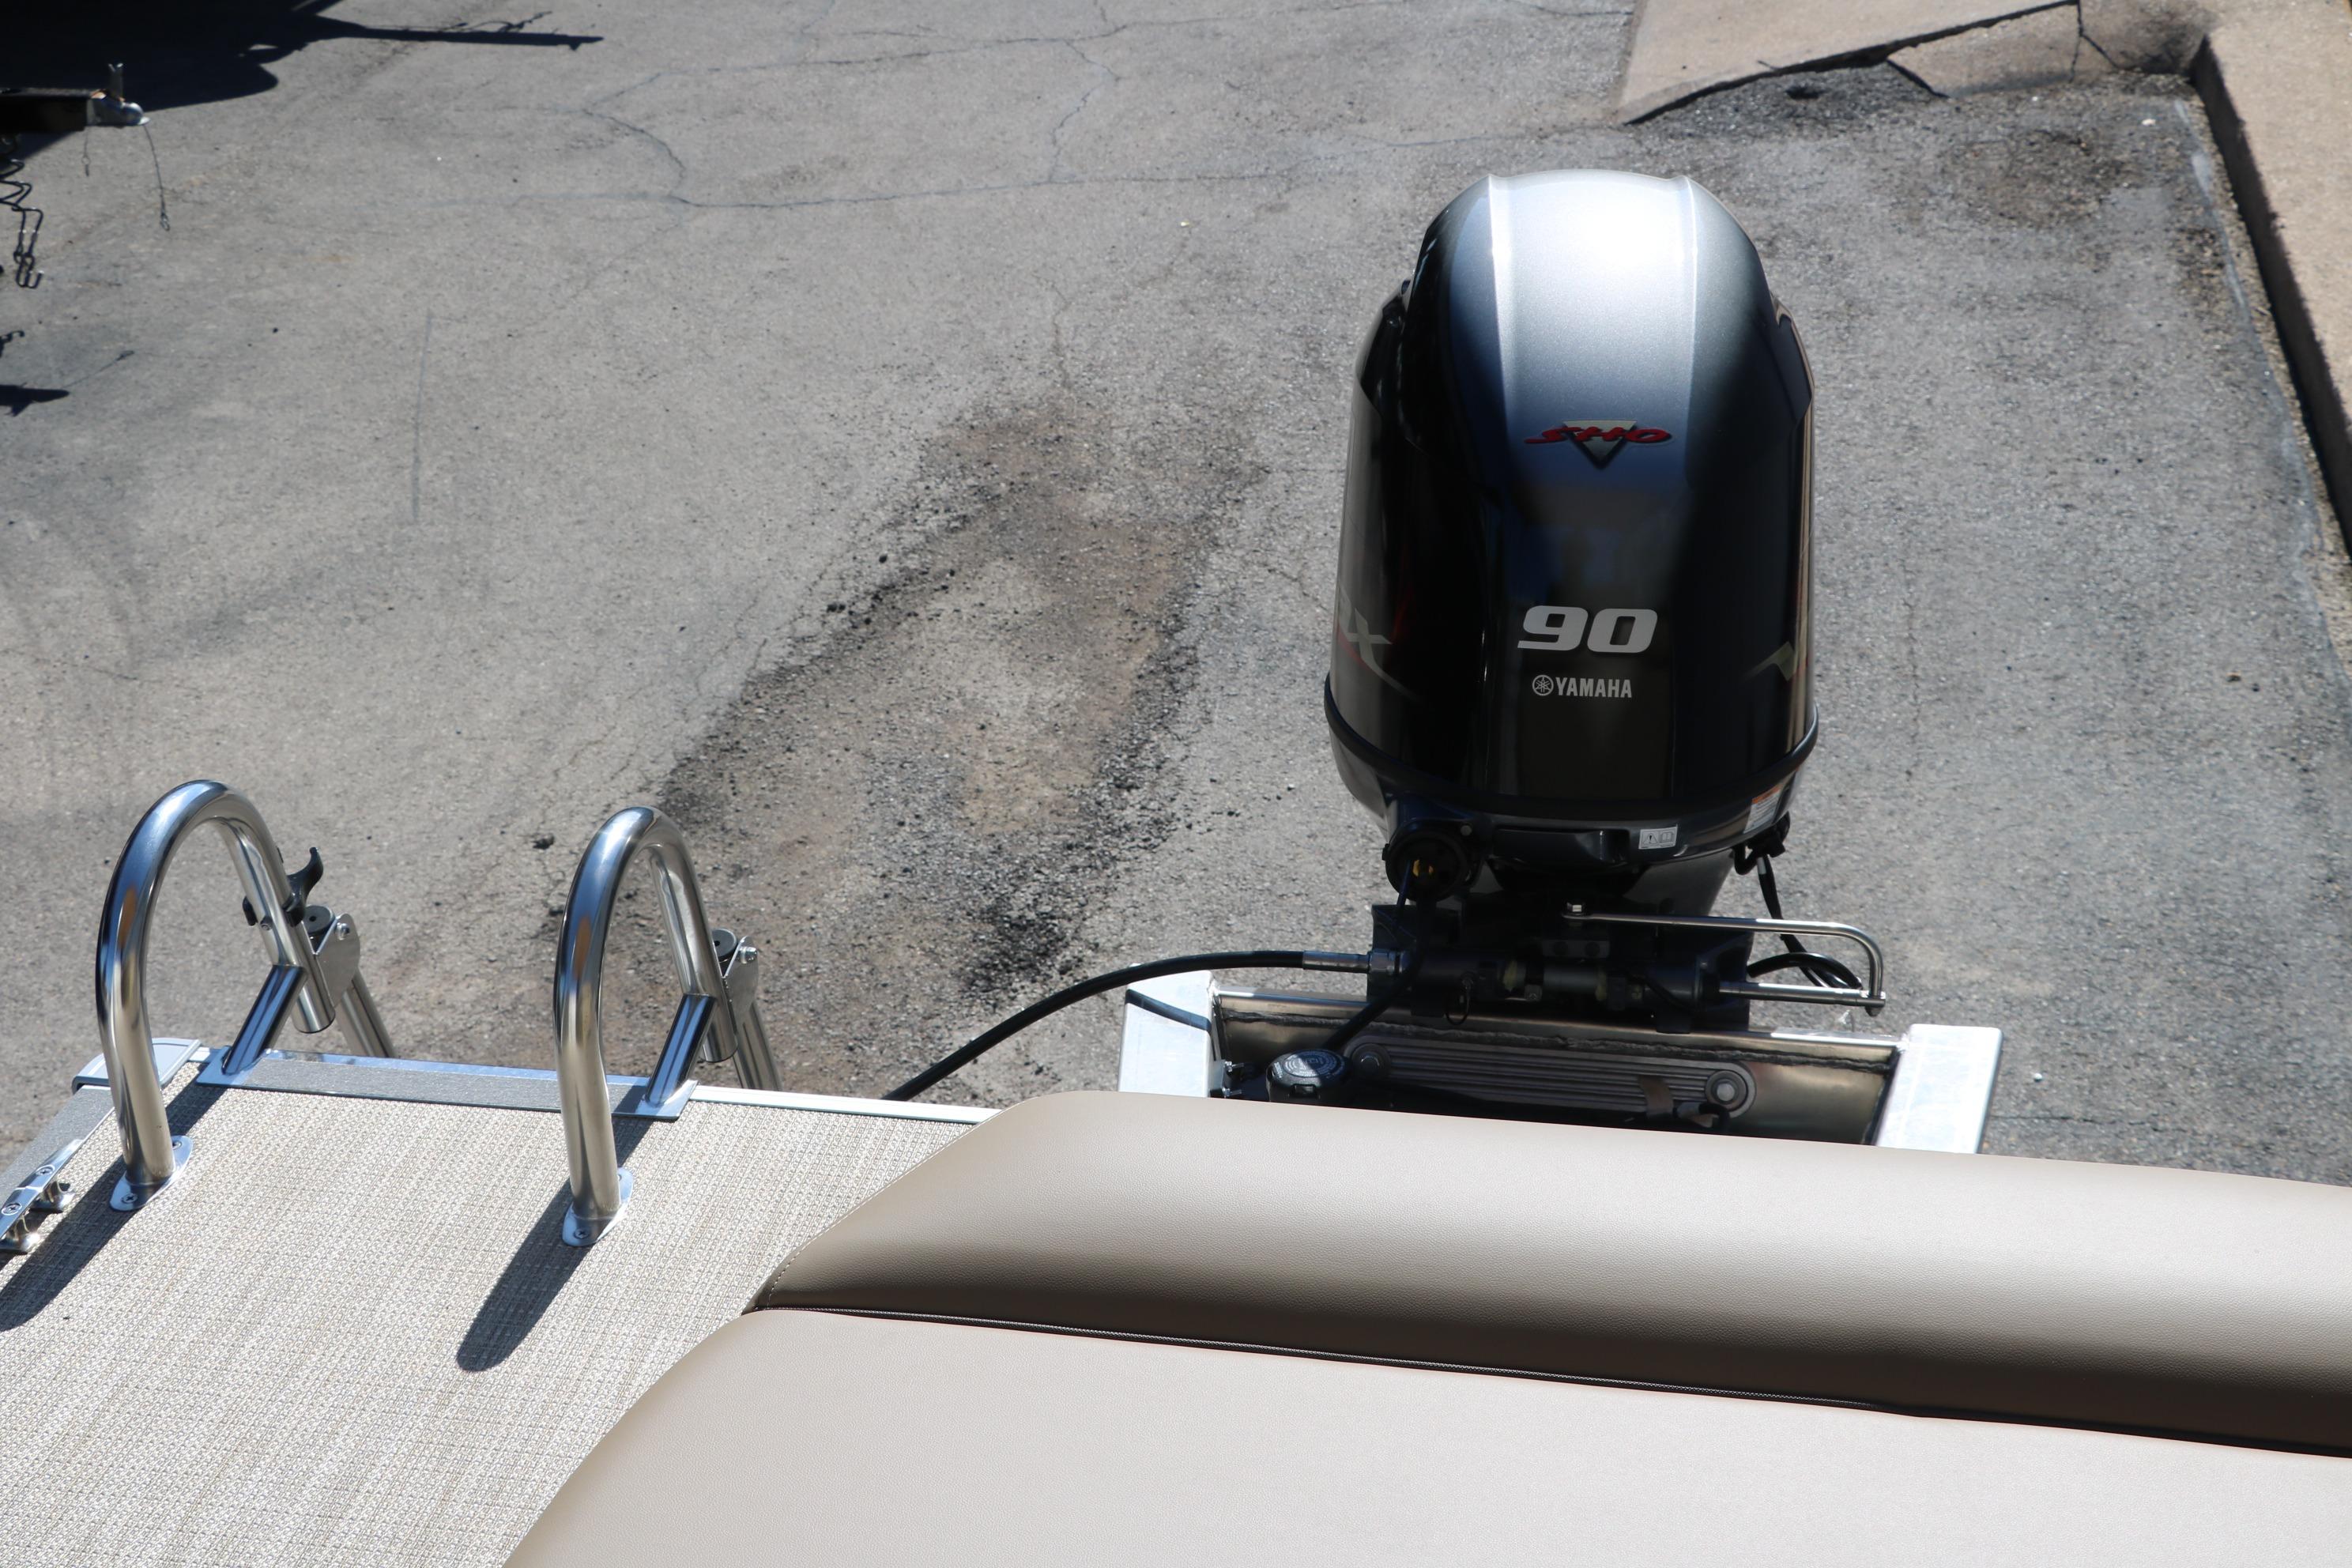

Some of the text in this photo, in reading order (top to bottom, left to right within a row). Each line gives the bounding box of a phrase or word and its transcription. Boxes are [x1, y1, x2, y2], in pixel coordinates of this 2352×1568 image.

[1525, 426, 1672, 443] SHO
[1517, 605, 1658, 654] 90
[1556, 677, 1632, 698] YAMAHA
